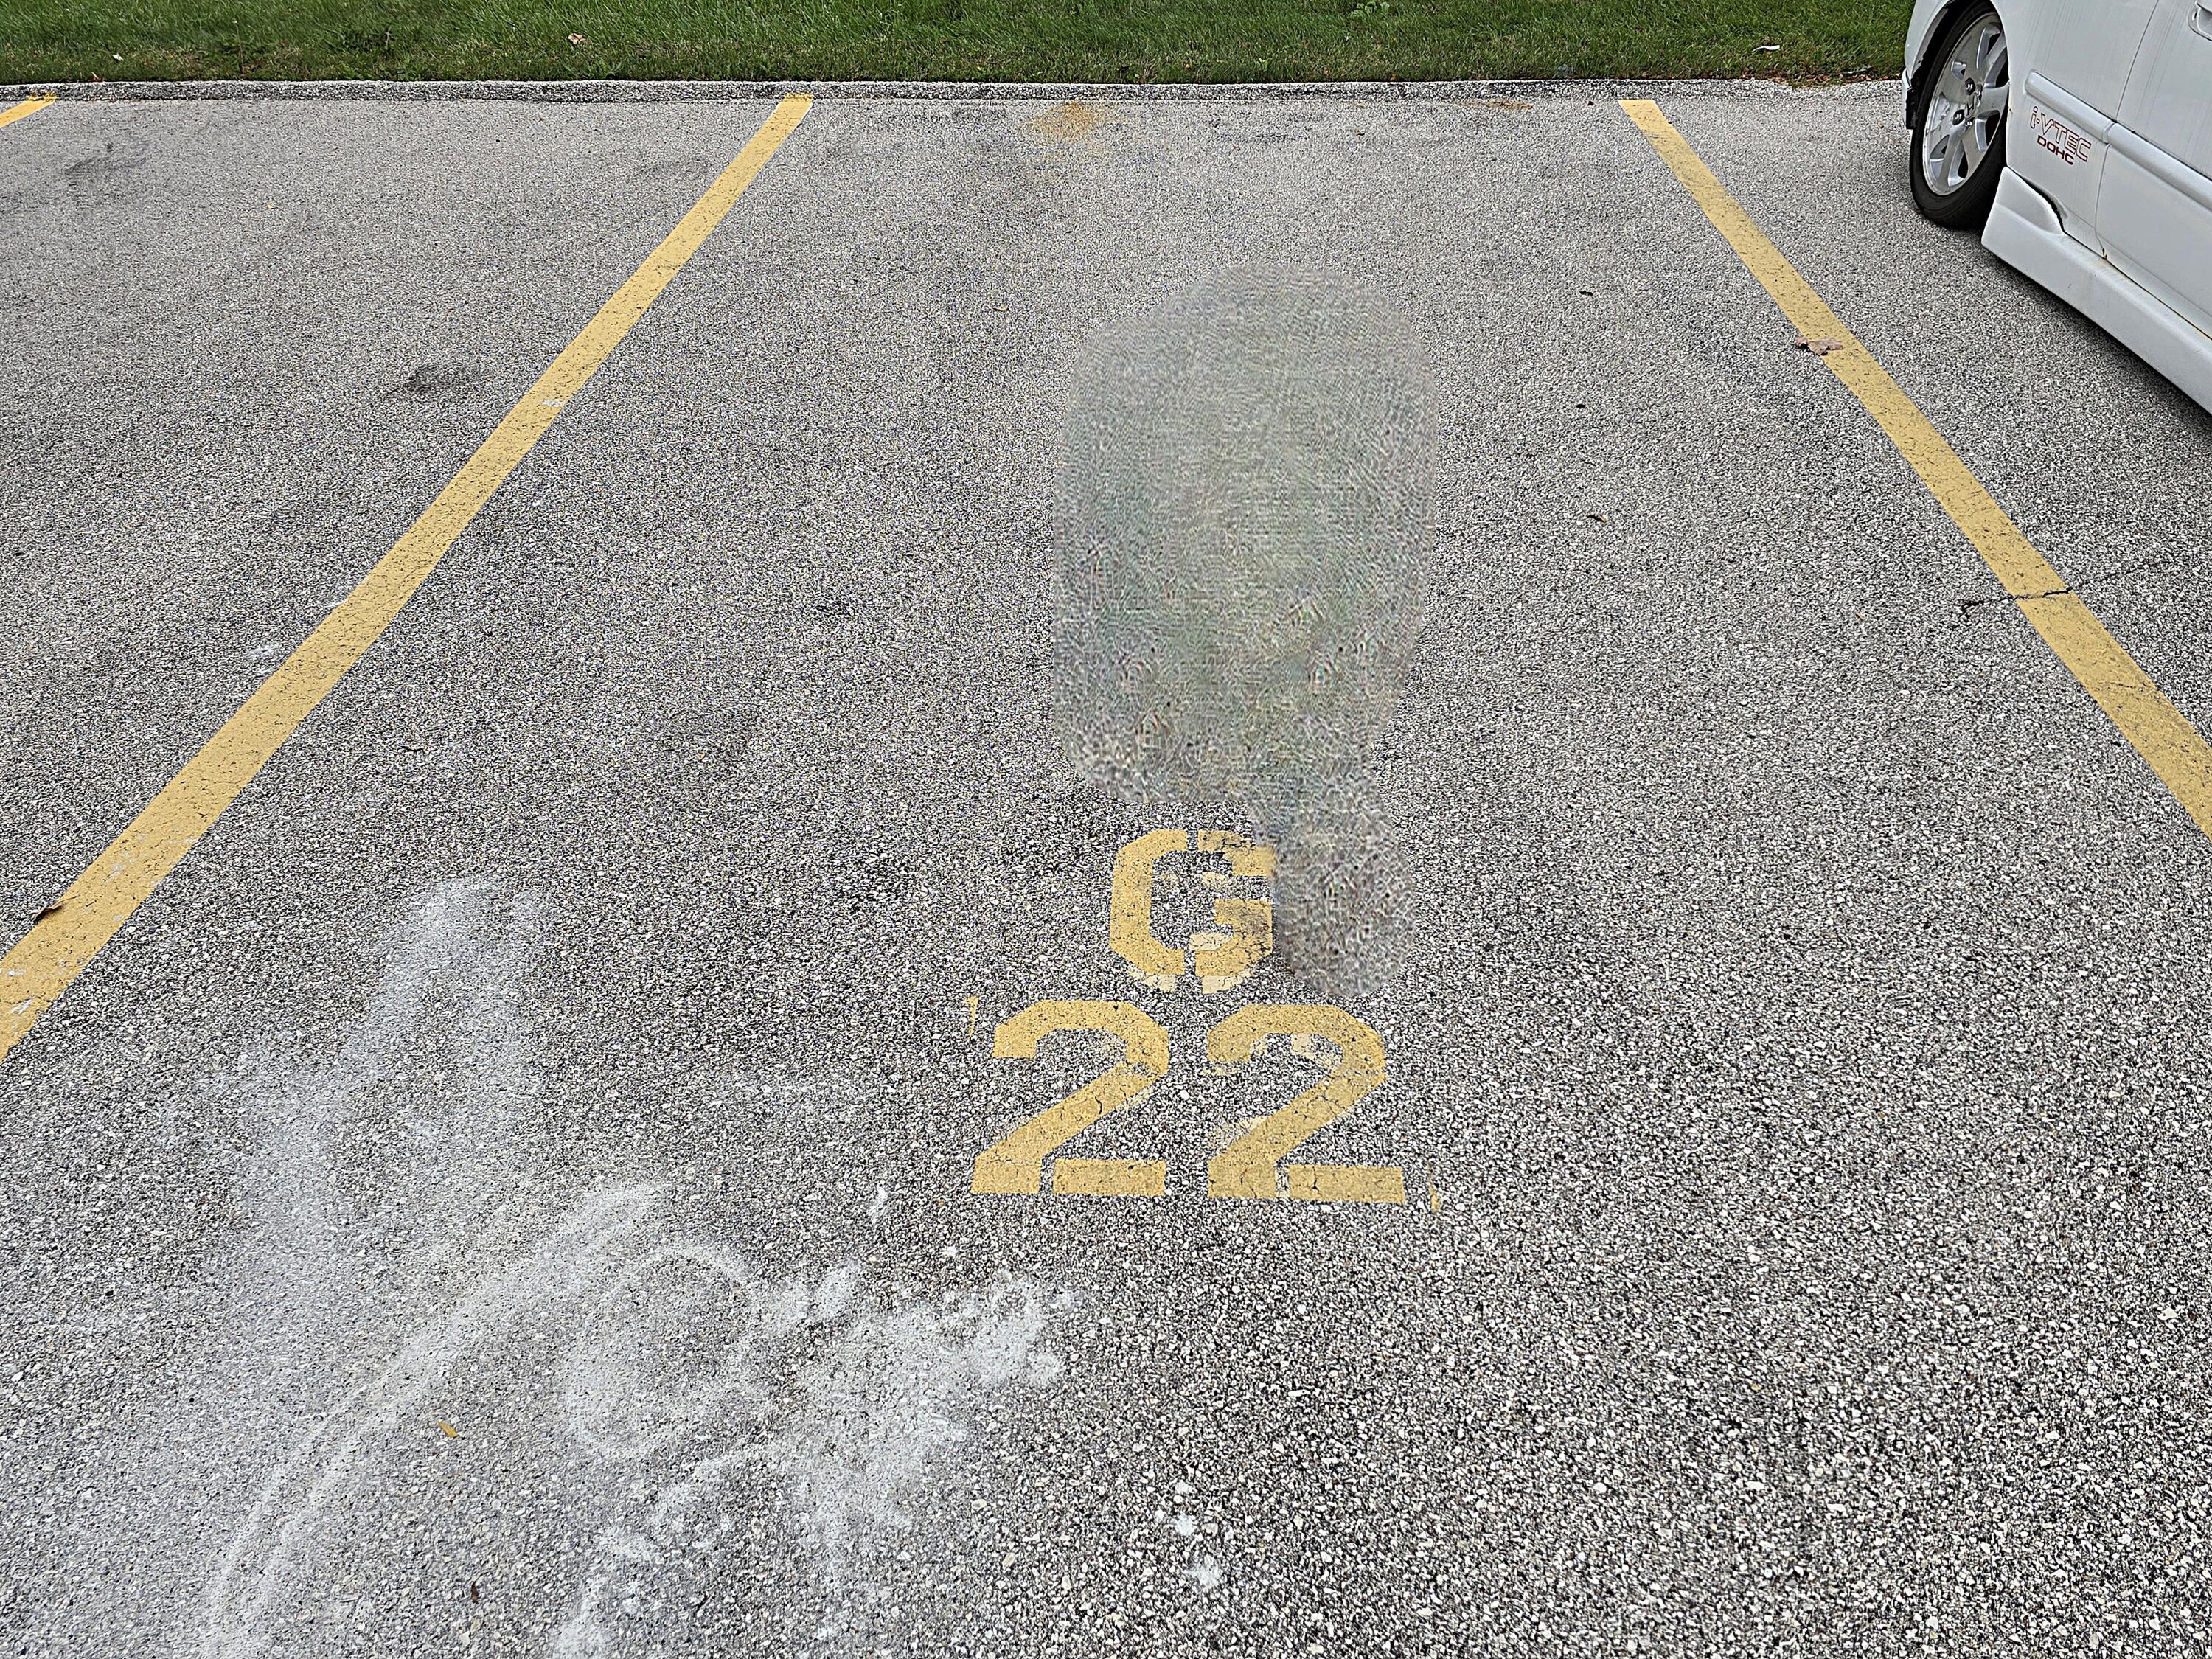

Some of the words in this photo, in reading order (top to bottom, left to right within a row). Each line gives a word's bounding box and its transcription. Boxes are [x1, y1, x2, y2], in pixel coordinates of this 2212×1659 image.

[2030, 105, 2091, 162] i-VTEC
[2037, 135, 2074, 165] DOHC
[1109, 829, 1276, 978] G
[970, 999, 1405, 1203] 22
